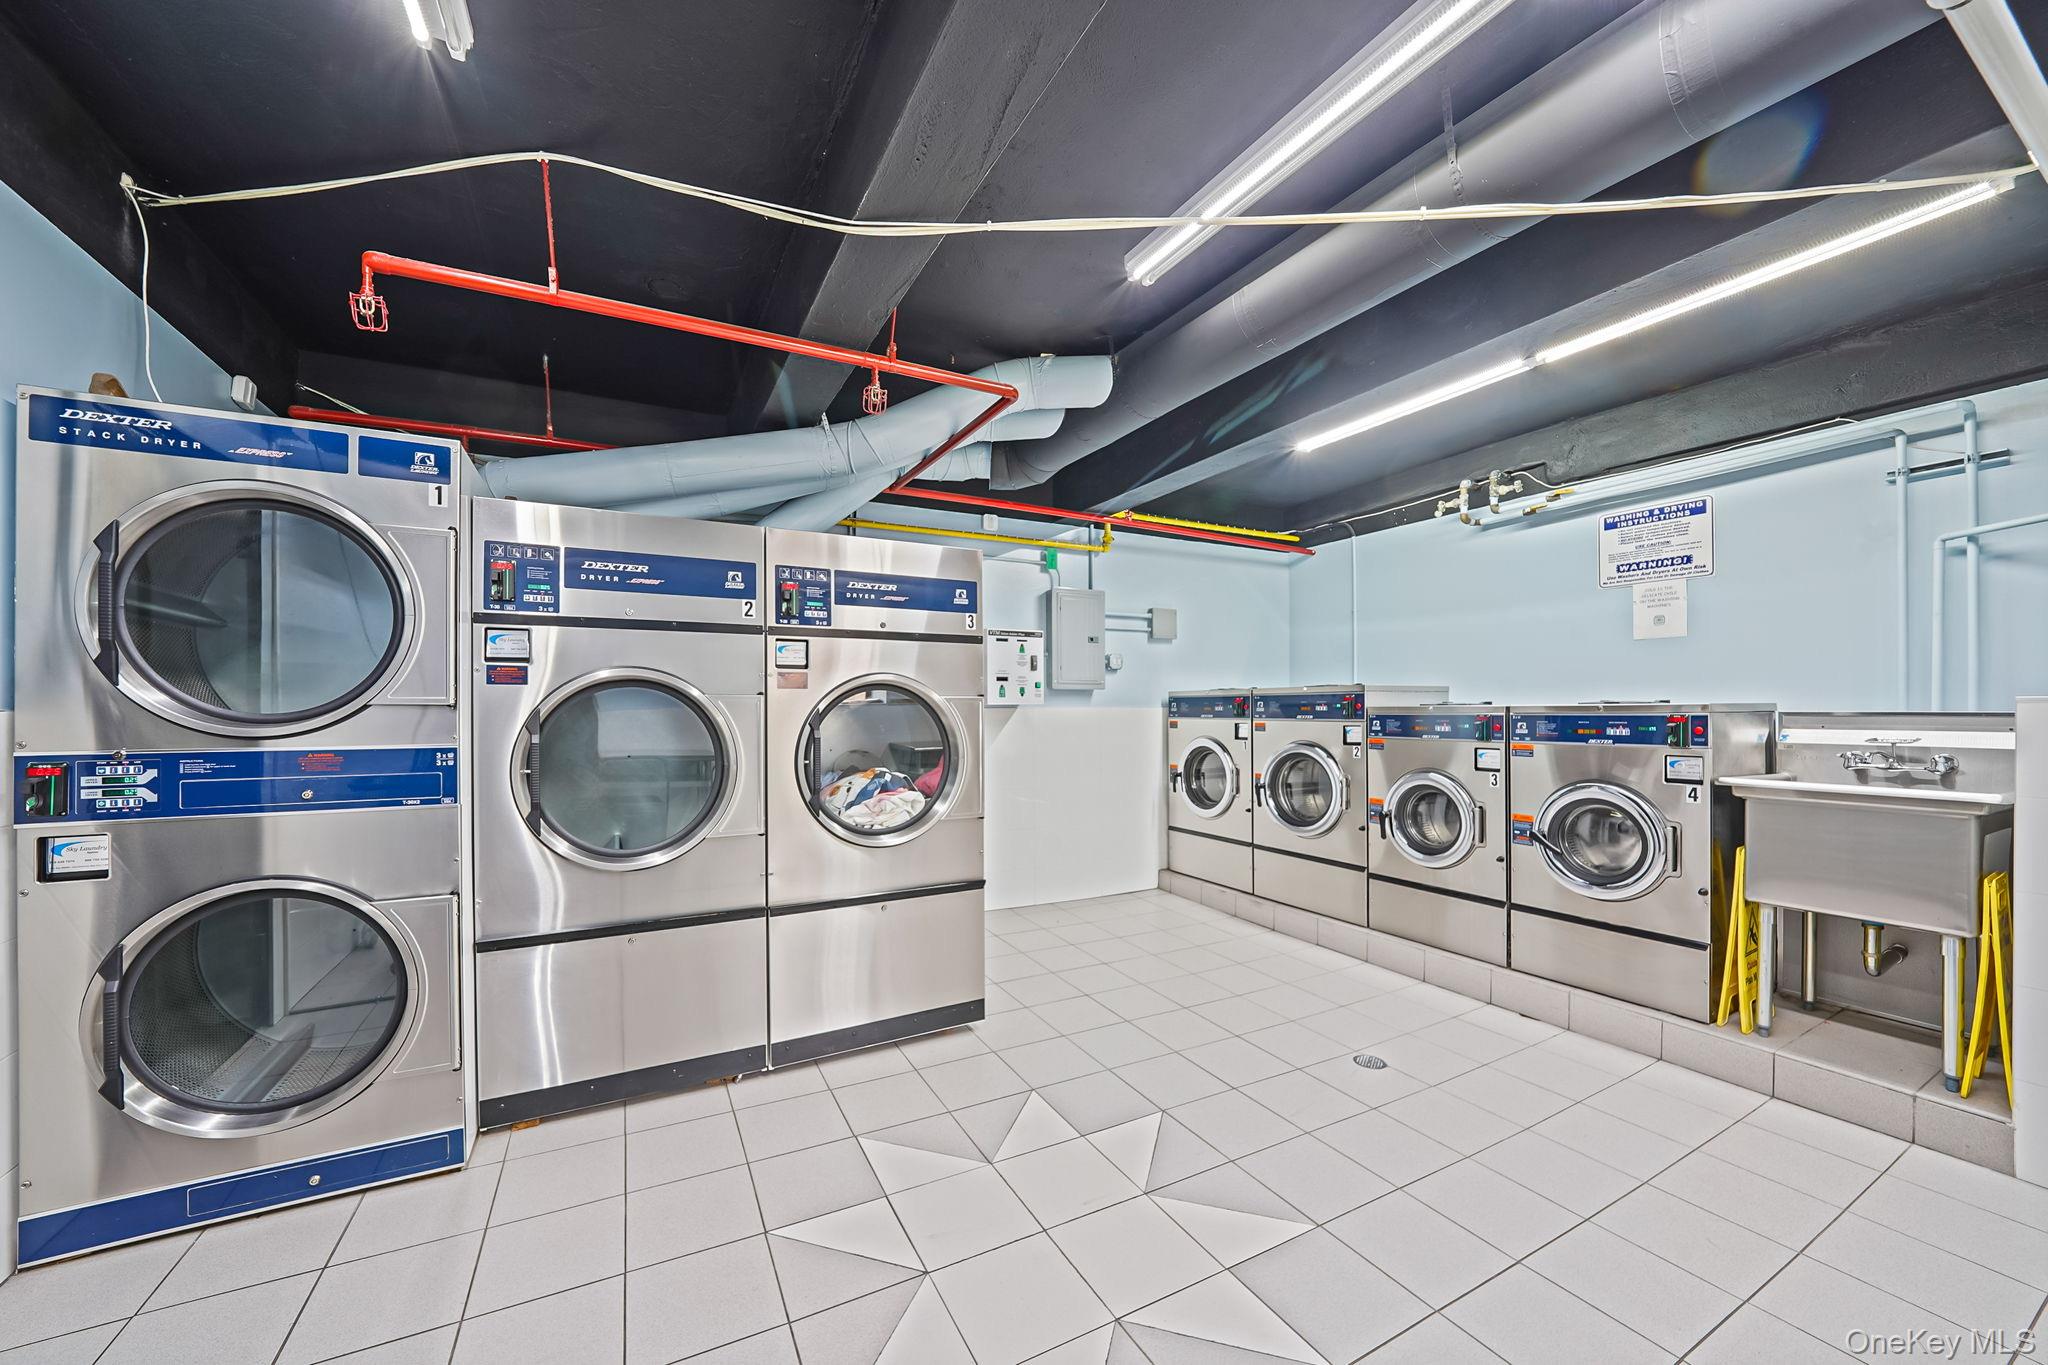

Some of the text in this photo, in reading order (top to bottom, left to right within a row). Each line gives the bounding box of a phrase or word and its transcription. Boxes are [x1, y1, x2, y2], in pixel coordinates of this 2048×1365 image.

[59, 408, 173, 431] DEXTER
[59, 426, 201, 450] STACK DRYER
[434, 485, 443, 506] 1
[1606, 510, 1649, 524] WASHING
[1664, 501, 1703, 513] DRYING
[1617, 510, 1691, 528] INSTRUCTIONS
[581, 561, 649, 573] DEXTER
[1619, 556, 1688, 573] WARNING!
[580, 574, 619, 582] DRYER
[1617, 572, 1639, 580] Washers
[847, 581, 898, 592] DEXTER
[846, 592, 875, 600] DRYER
[744, 601, 754, 617] 2
[967, 614, 975, 629] 3
[1354, 746, 1360, 757] 2
[1491, 774, 1498, 786] 3
[1688, 787, 1698, 802] 4
